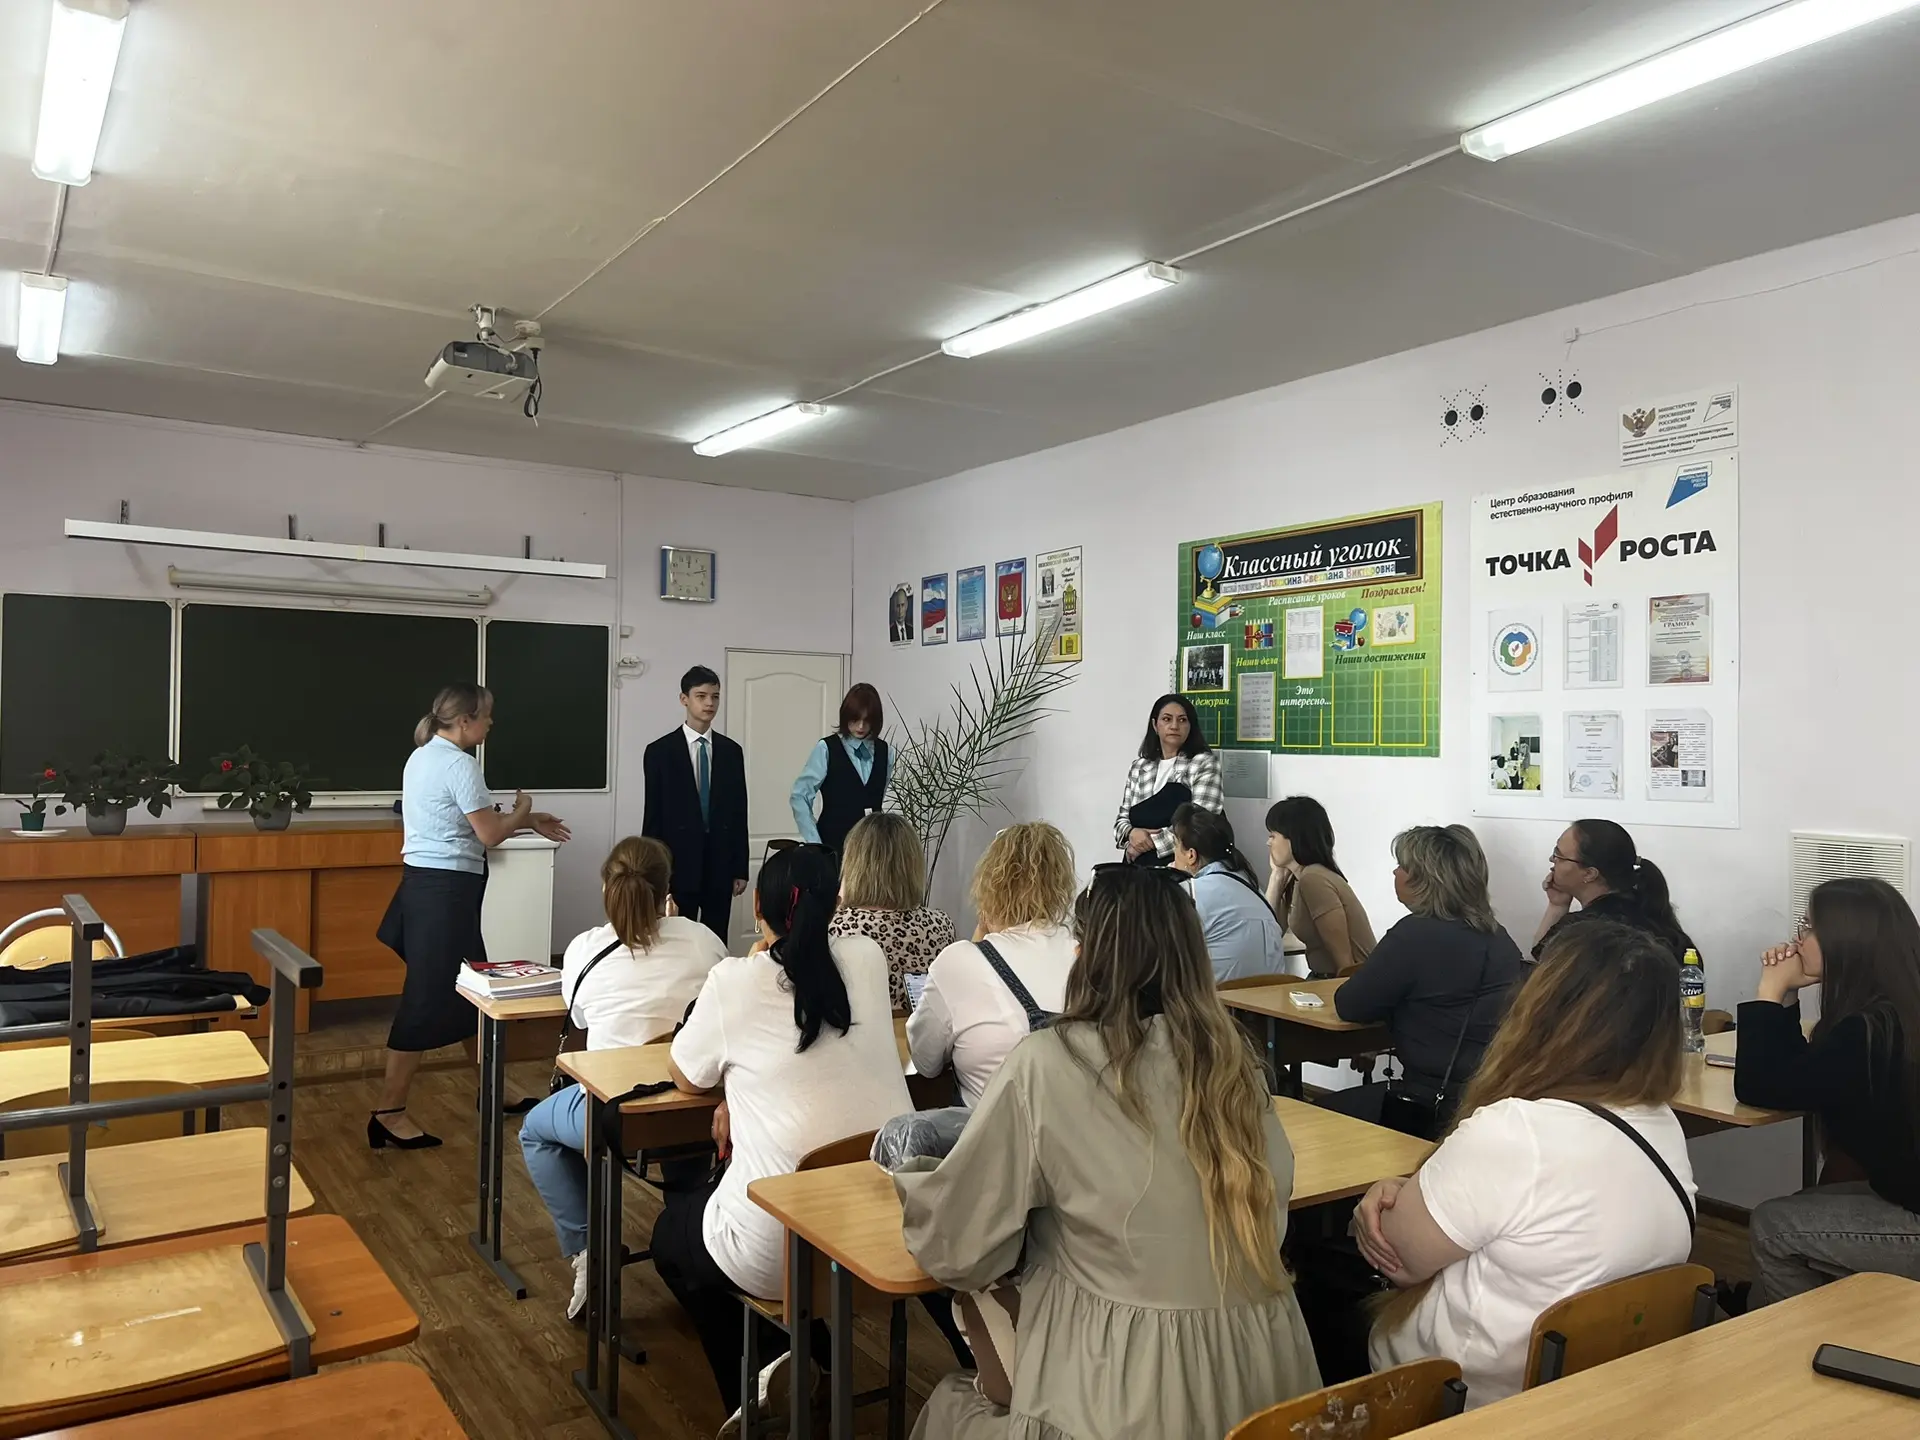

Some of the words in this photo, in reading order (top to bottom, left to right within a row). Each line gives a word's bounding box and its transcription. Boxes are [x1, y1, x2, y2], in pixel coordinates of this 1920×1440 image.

[1490, 495, 1516, 509] Центр
[1517, 487, 1575, 504] образования
[1490, 498, 1587, 520] естественно-научного
[1588, 490, 1634, 505] профиля
[1222, 543, 1323, 578] Классный
[1325, 537, 1402, 571] уголок
[1485, 548, 1571, 577] ТОЧКА
[1619, 530, 1717, 562] РОСТА
[1268, 593, 1315, 606] Расписание
[1316, 590, 1346, 603] уроков
[1361, 582, 1427, 599] Поздравляем!
[1186, 631, 1204, 640] Наш
[1205, 630, 1226, 639] класс
[1236, 657, 1259, 667] Наши
[1260, 656, 1279, 665] дела
[1334, 654, 1362, 665] Наши
[1364, 651, 1427, 663] достижения
[1295, 685, 1314, 695] Это
[1195, 697, 1230, 707] дежурим
